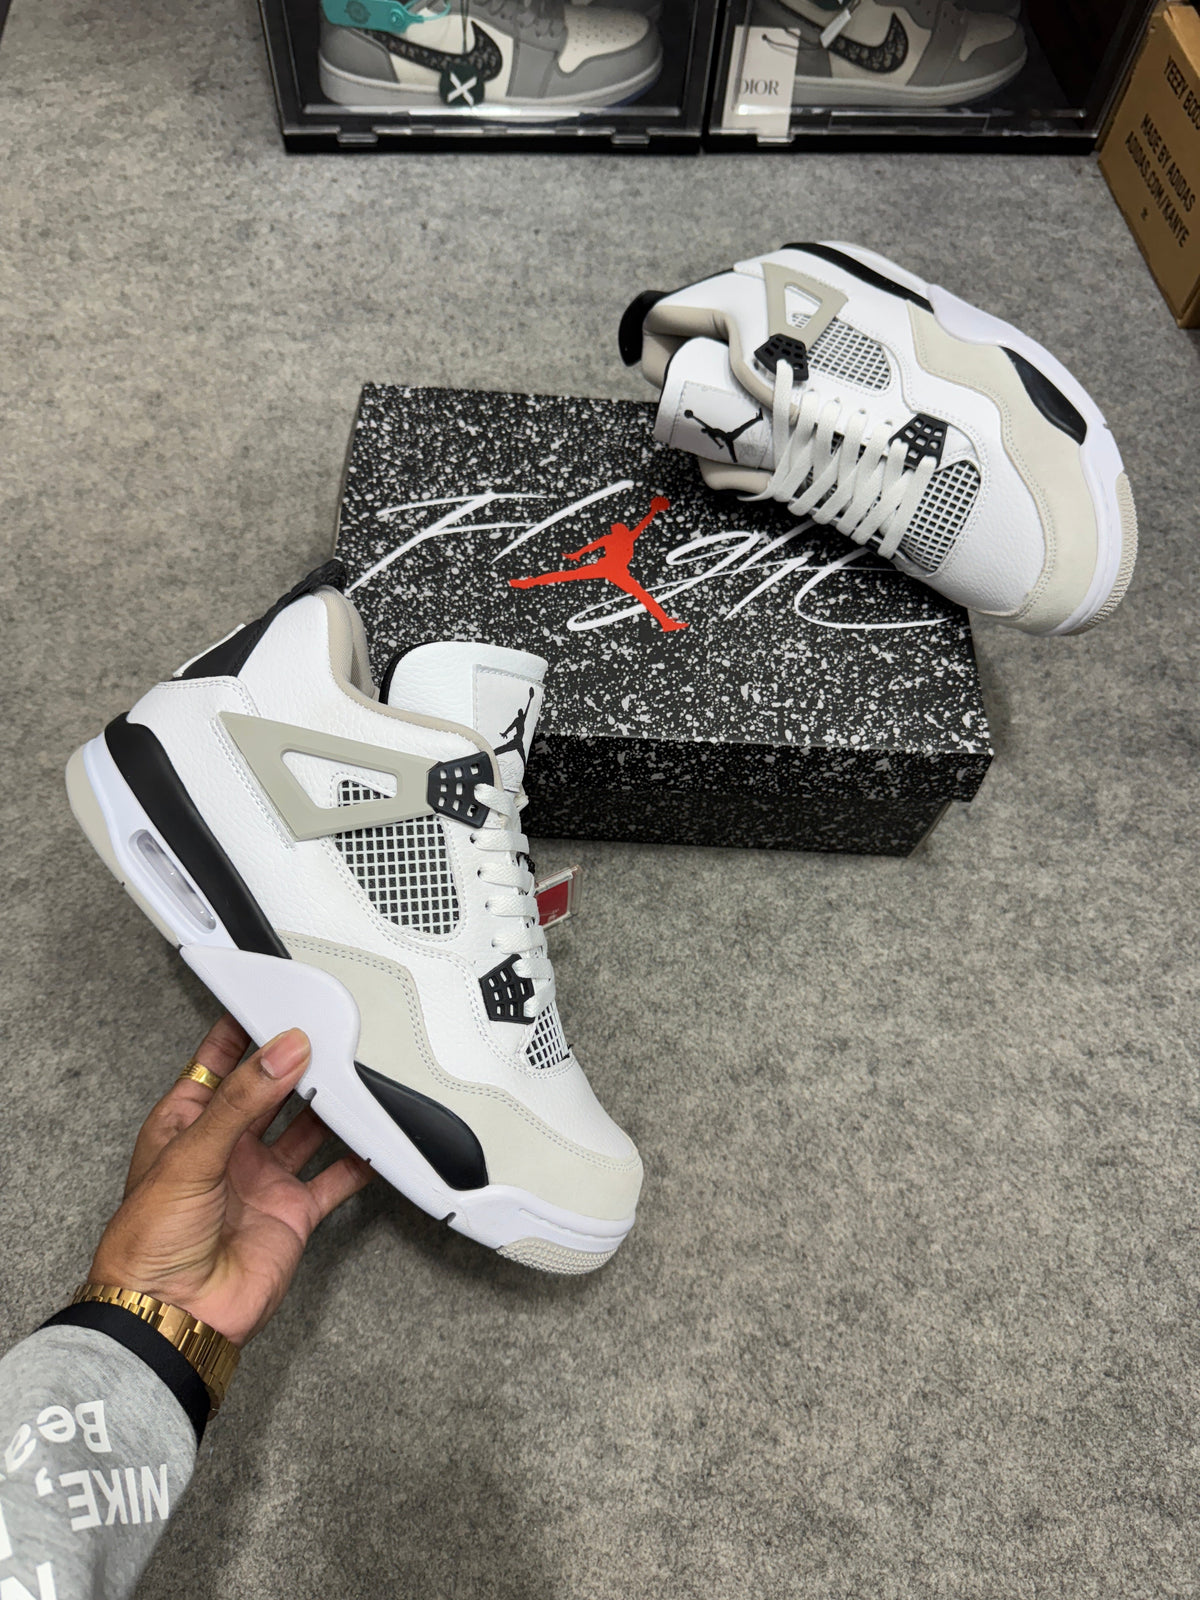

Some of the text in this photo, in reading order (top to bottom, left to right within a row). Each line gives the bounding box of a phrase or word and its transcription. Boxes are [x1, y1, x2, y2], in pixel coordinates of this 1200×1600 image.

[1163, 55, 1188, 99] YEEZY
[1141, 113, 1196, 212] MADE BY ADIDAS
